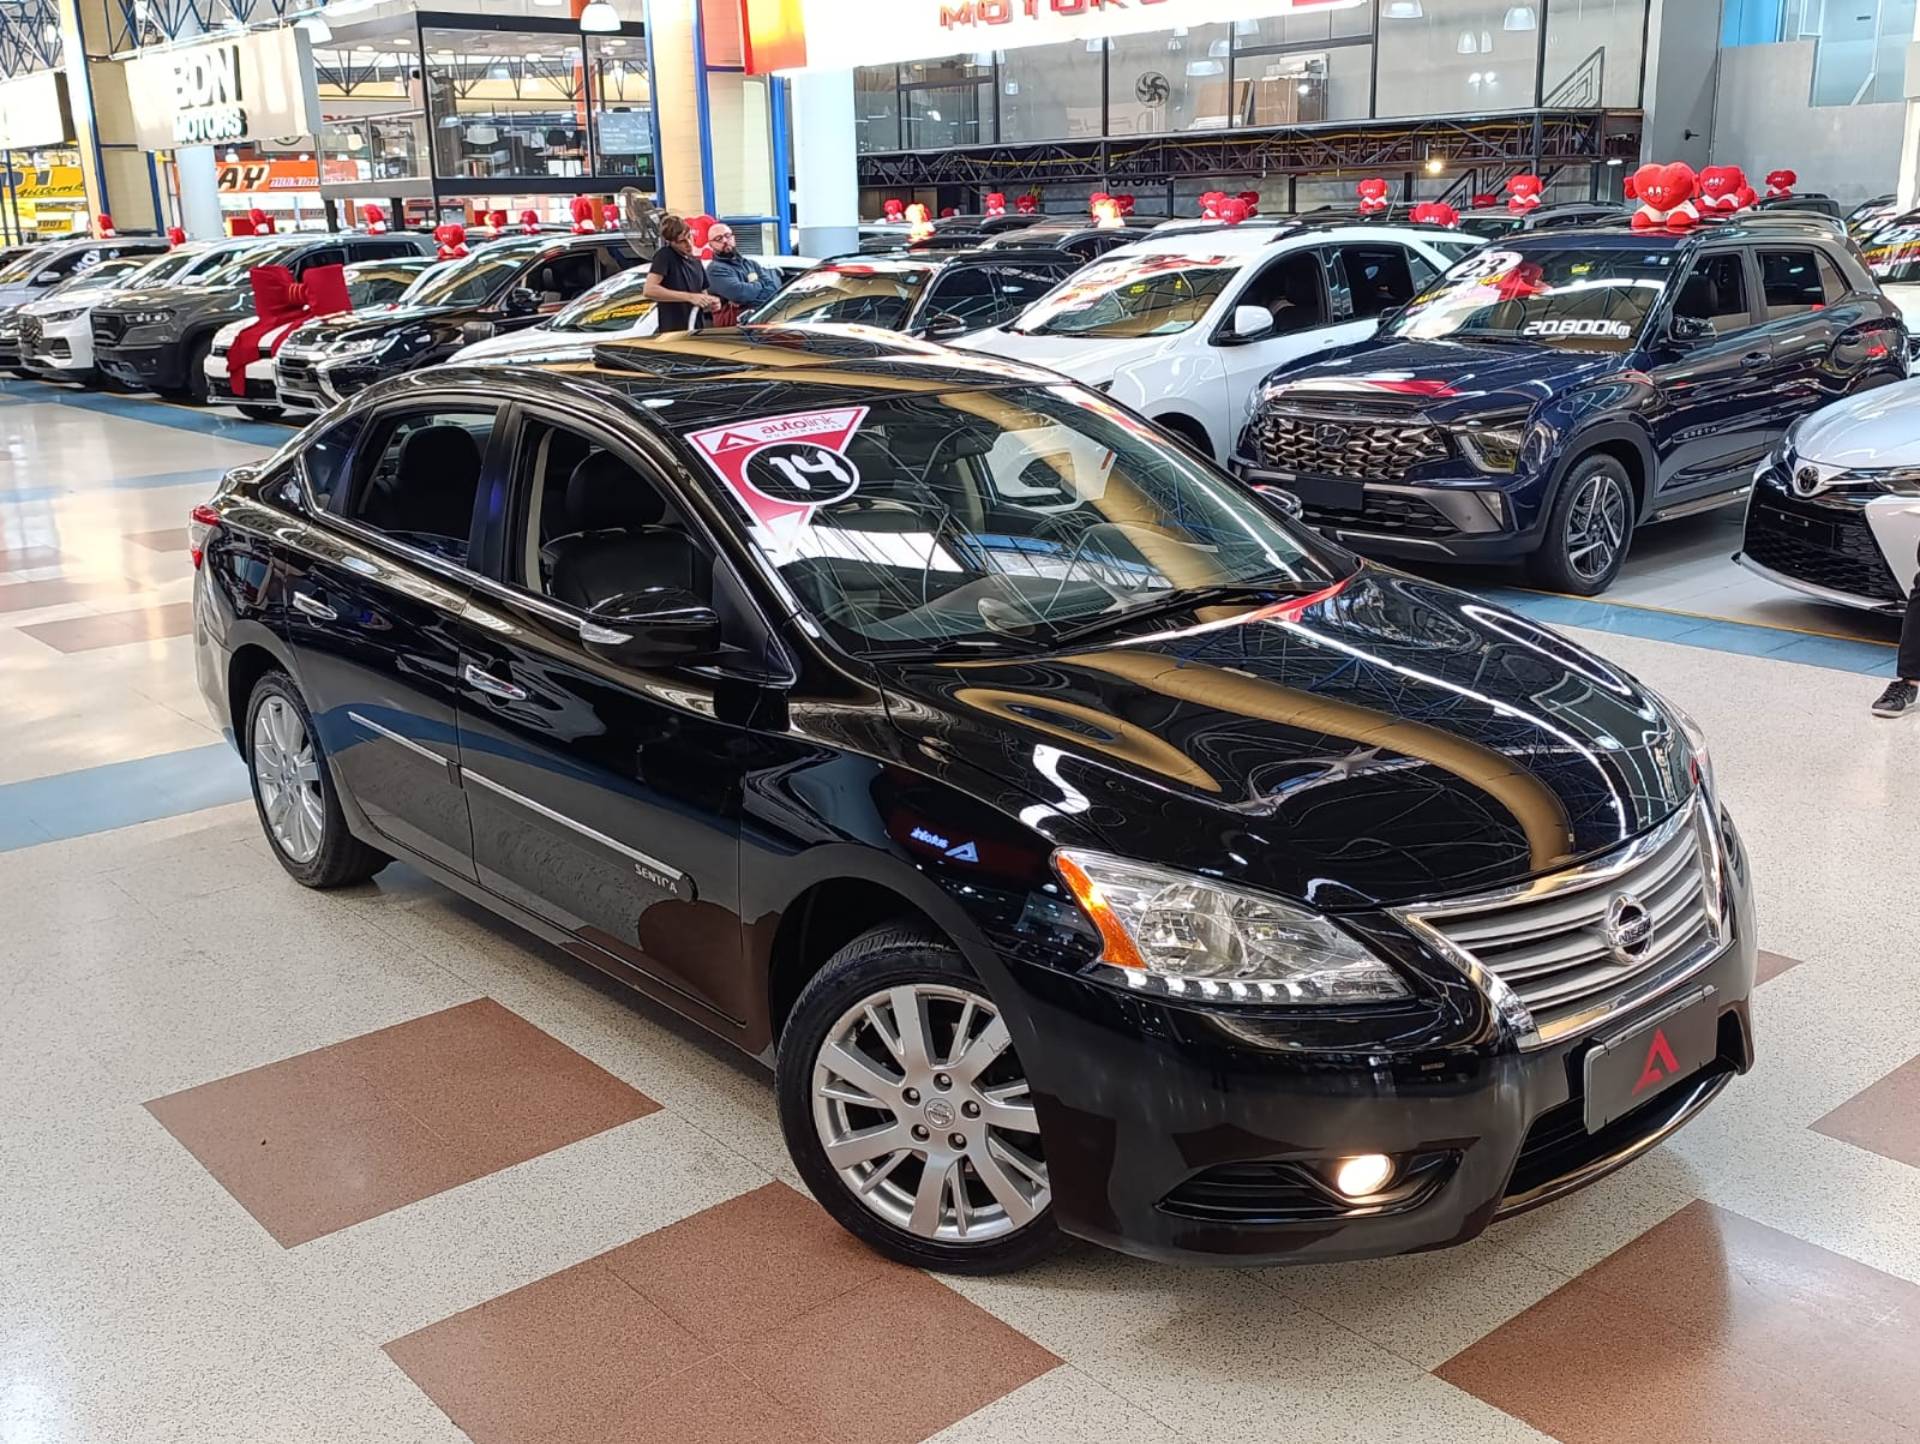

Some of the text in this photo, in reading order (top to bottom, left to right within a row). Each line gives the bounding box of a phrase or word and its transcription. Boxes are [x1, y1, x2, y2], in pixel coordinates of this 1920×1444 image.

[1455, 257, 1508, 281] 23
[760, 415, 834, 434] autolink
[769, 451, 851, 491] 14
[634, 863, 678, 894] SENTRA
